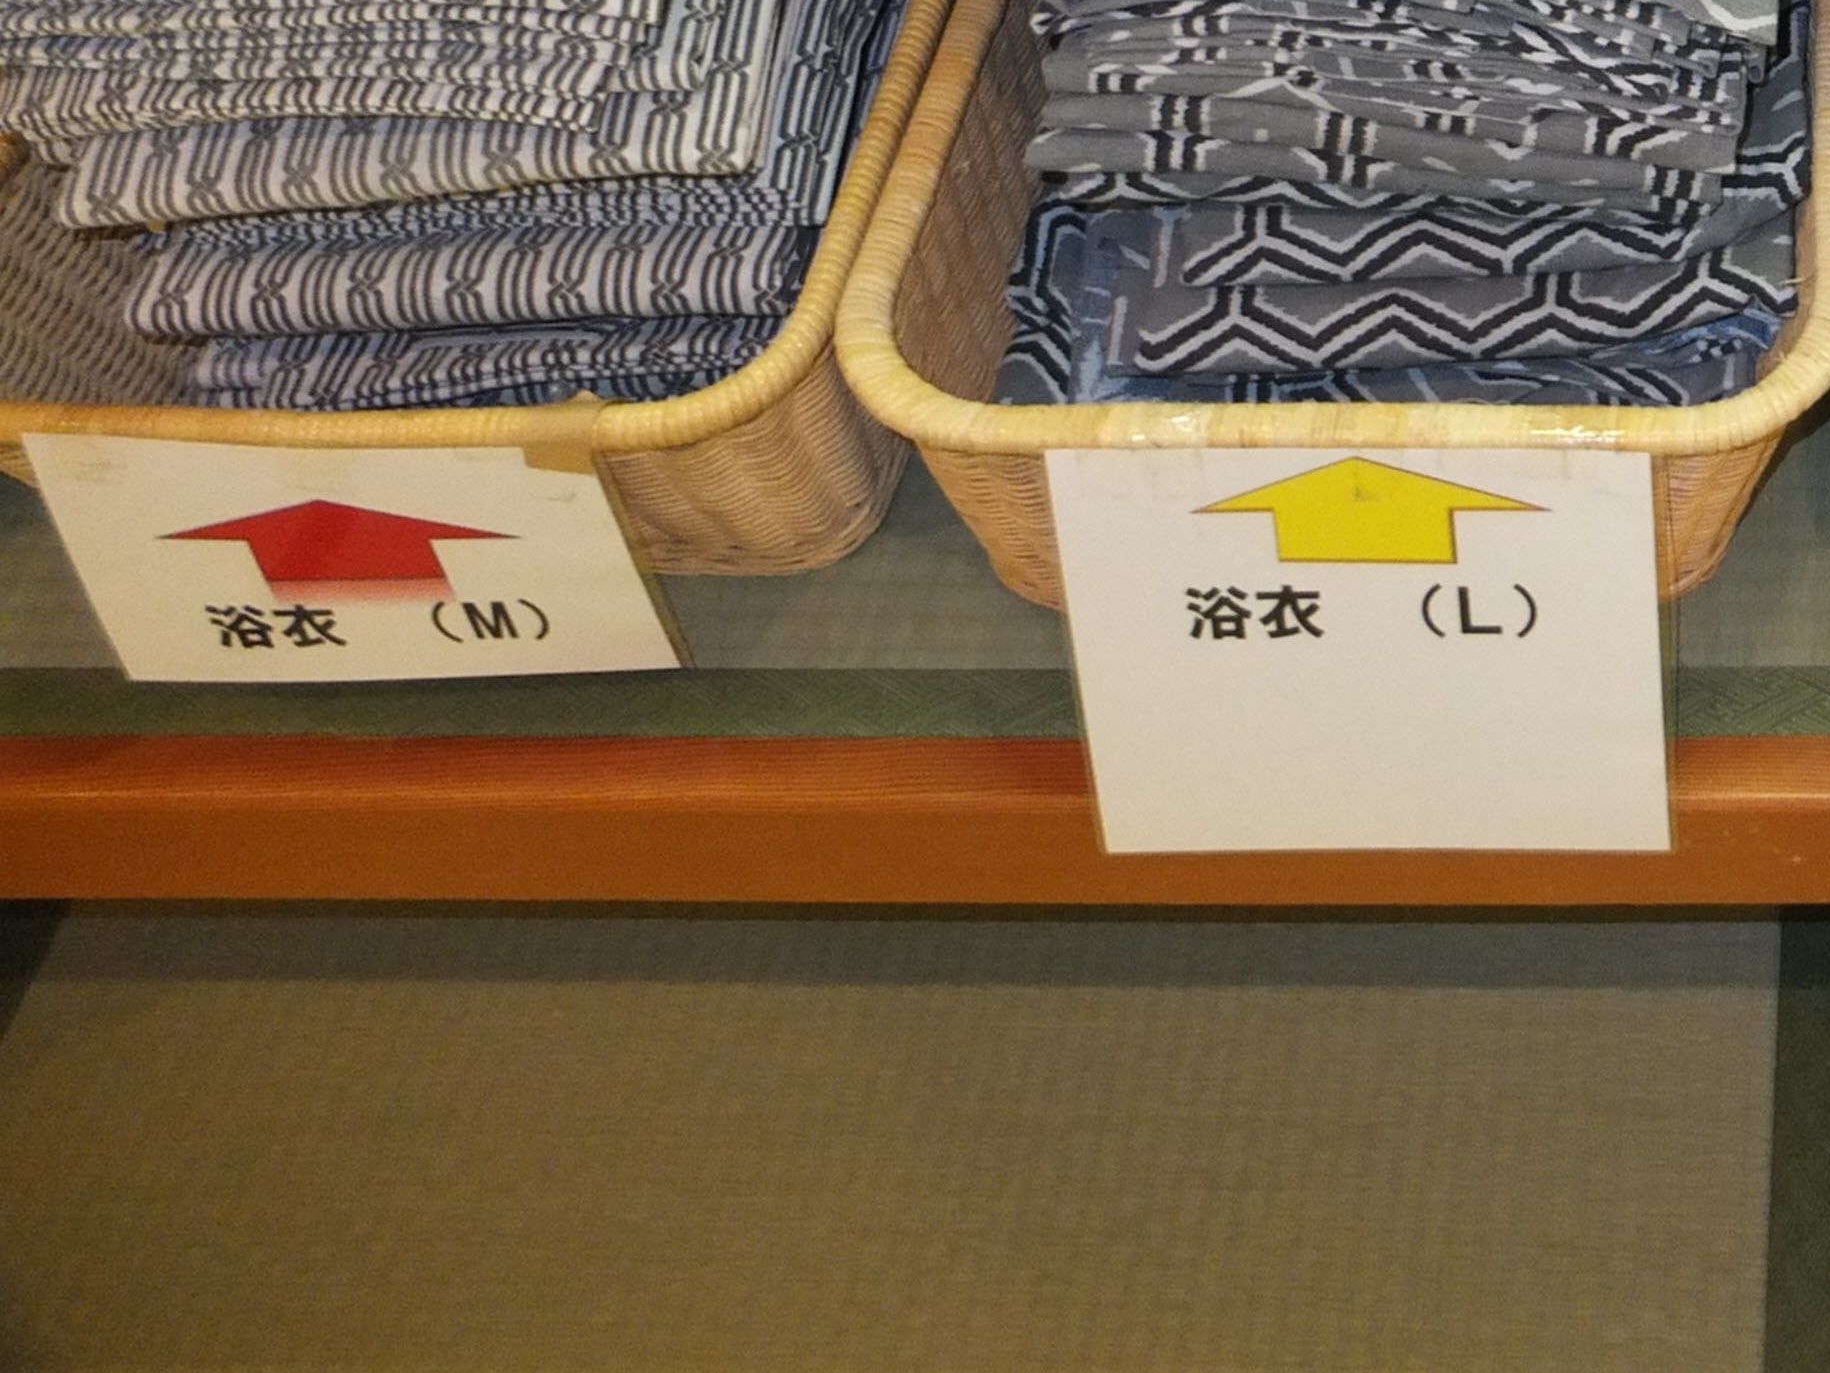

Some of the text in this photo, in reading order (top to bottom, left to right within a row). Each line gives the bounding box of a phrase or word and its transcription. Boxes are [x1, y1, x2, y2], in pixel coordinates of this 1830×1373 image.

[204, 598, 549, 649] 浴衣 (M)
[1185, 583, 1537, 641] 浴衣 (L)
